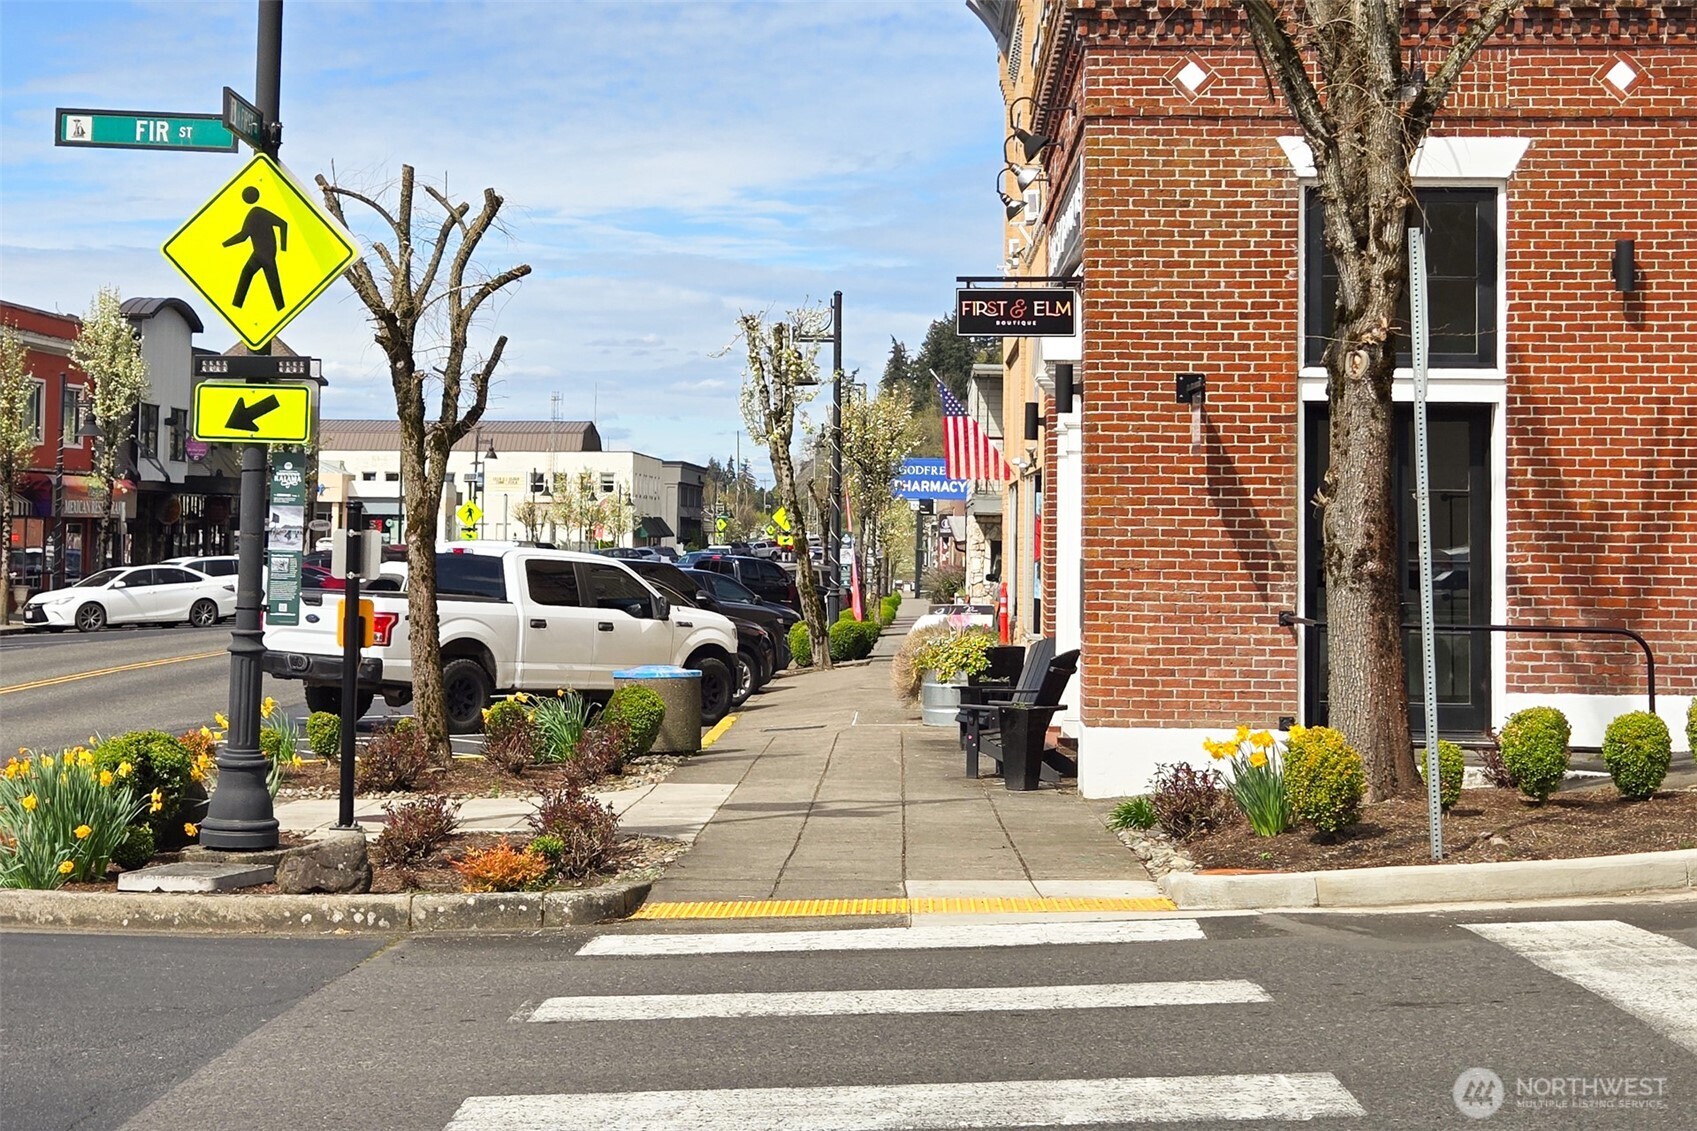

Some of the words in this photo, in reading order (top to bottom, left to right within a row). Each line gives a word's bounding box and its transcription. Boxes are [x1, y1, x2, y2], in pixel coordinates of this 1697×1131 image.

[136, 120, 169, 142] FIR
[179, 127, 193, 139] ST
[961, 300, 1008, 317] FIRST
[1009, 299, 1027, 318] &
[1033, 300, 1071, 317] ELM
[898, 465, 947, 476] GODFRE
[894, 480, 967, 493] PHARMACY
[64, 500, 91, 514] MEXICAN
